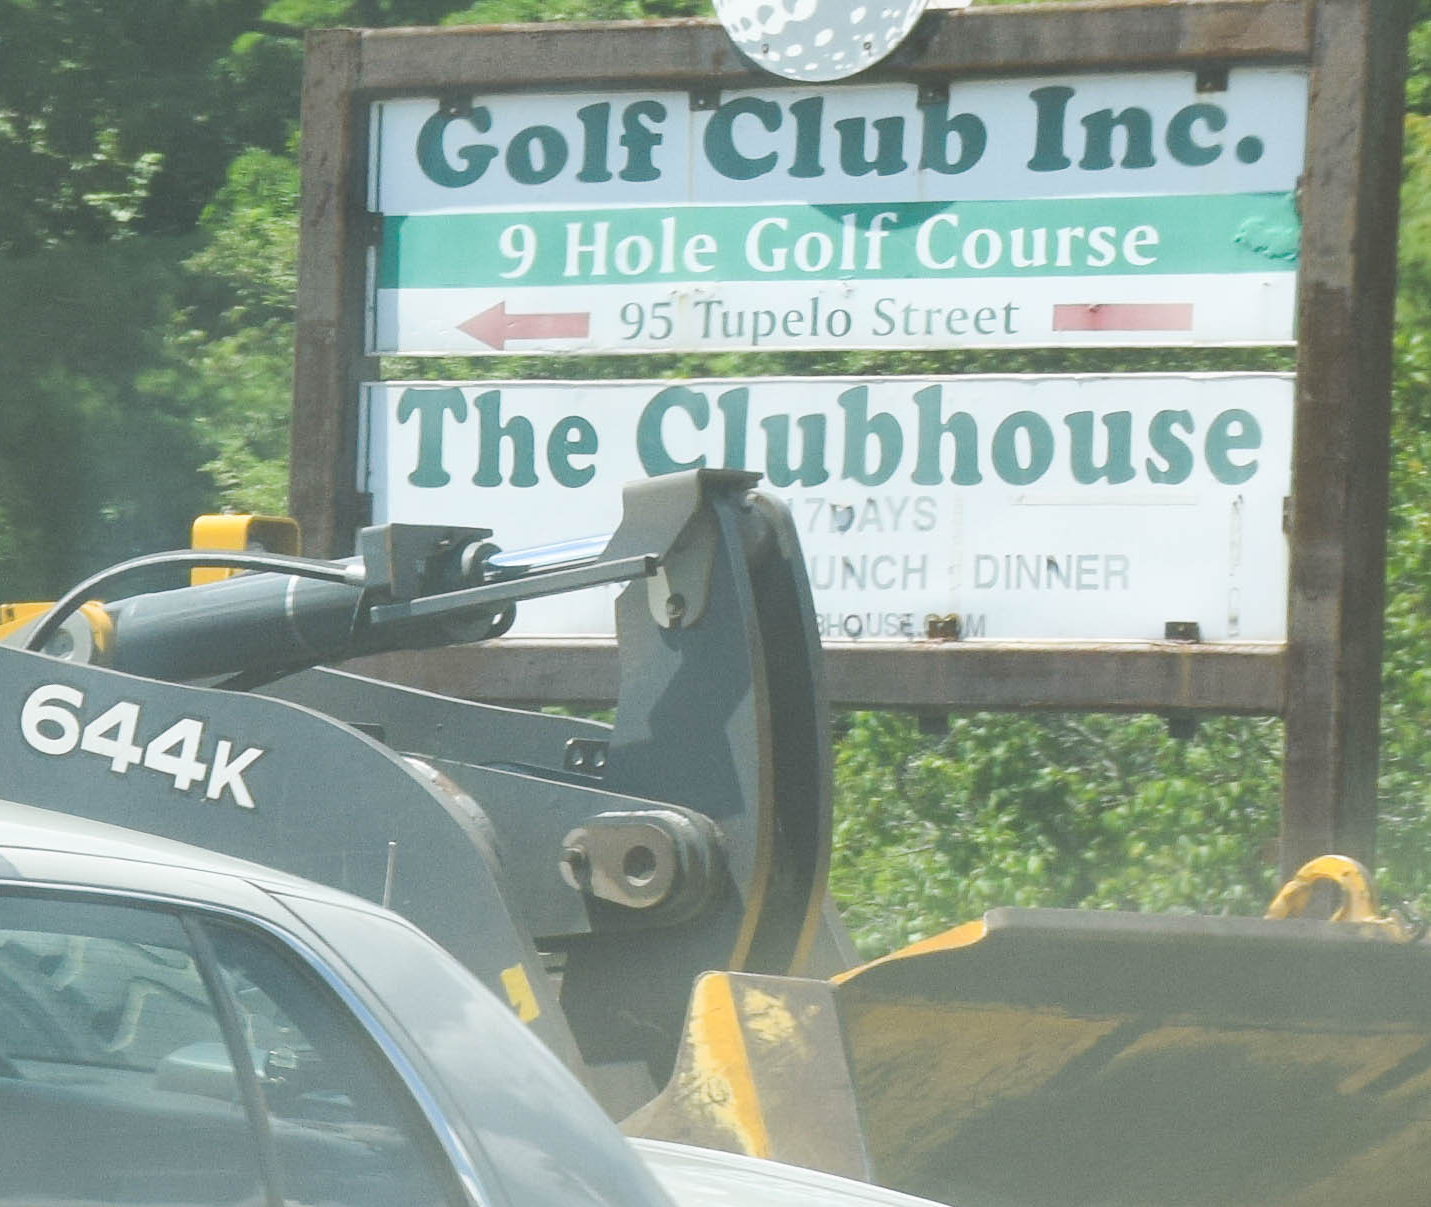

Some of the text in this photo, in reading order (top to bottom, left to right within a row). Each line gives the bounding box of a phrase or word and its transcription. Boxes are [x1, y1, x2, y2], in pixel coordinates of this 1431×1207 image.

[416, 85, 1265, 188] Golf Club Inc.
[498, 212, 1160, 279] 9 Hole Golf Course
[620, 296, 1020, 346] 95 Tupelo Street
[396, 384, 1263, 488] The Clubhouse
[810, 554, 1131, 591] UNCH DINNER
[20, 684, 264, 809] 644K
